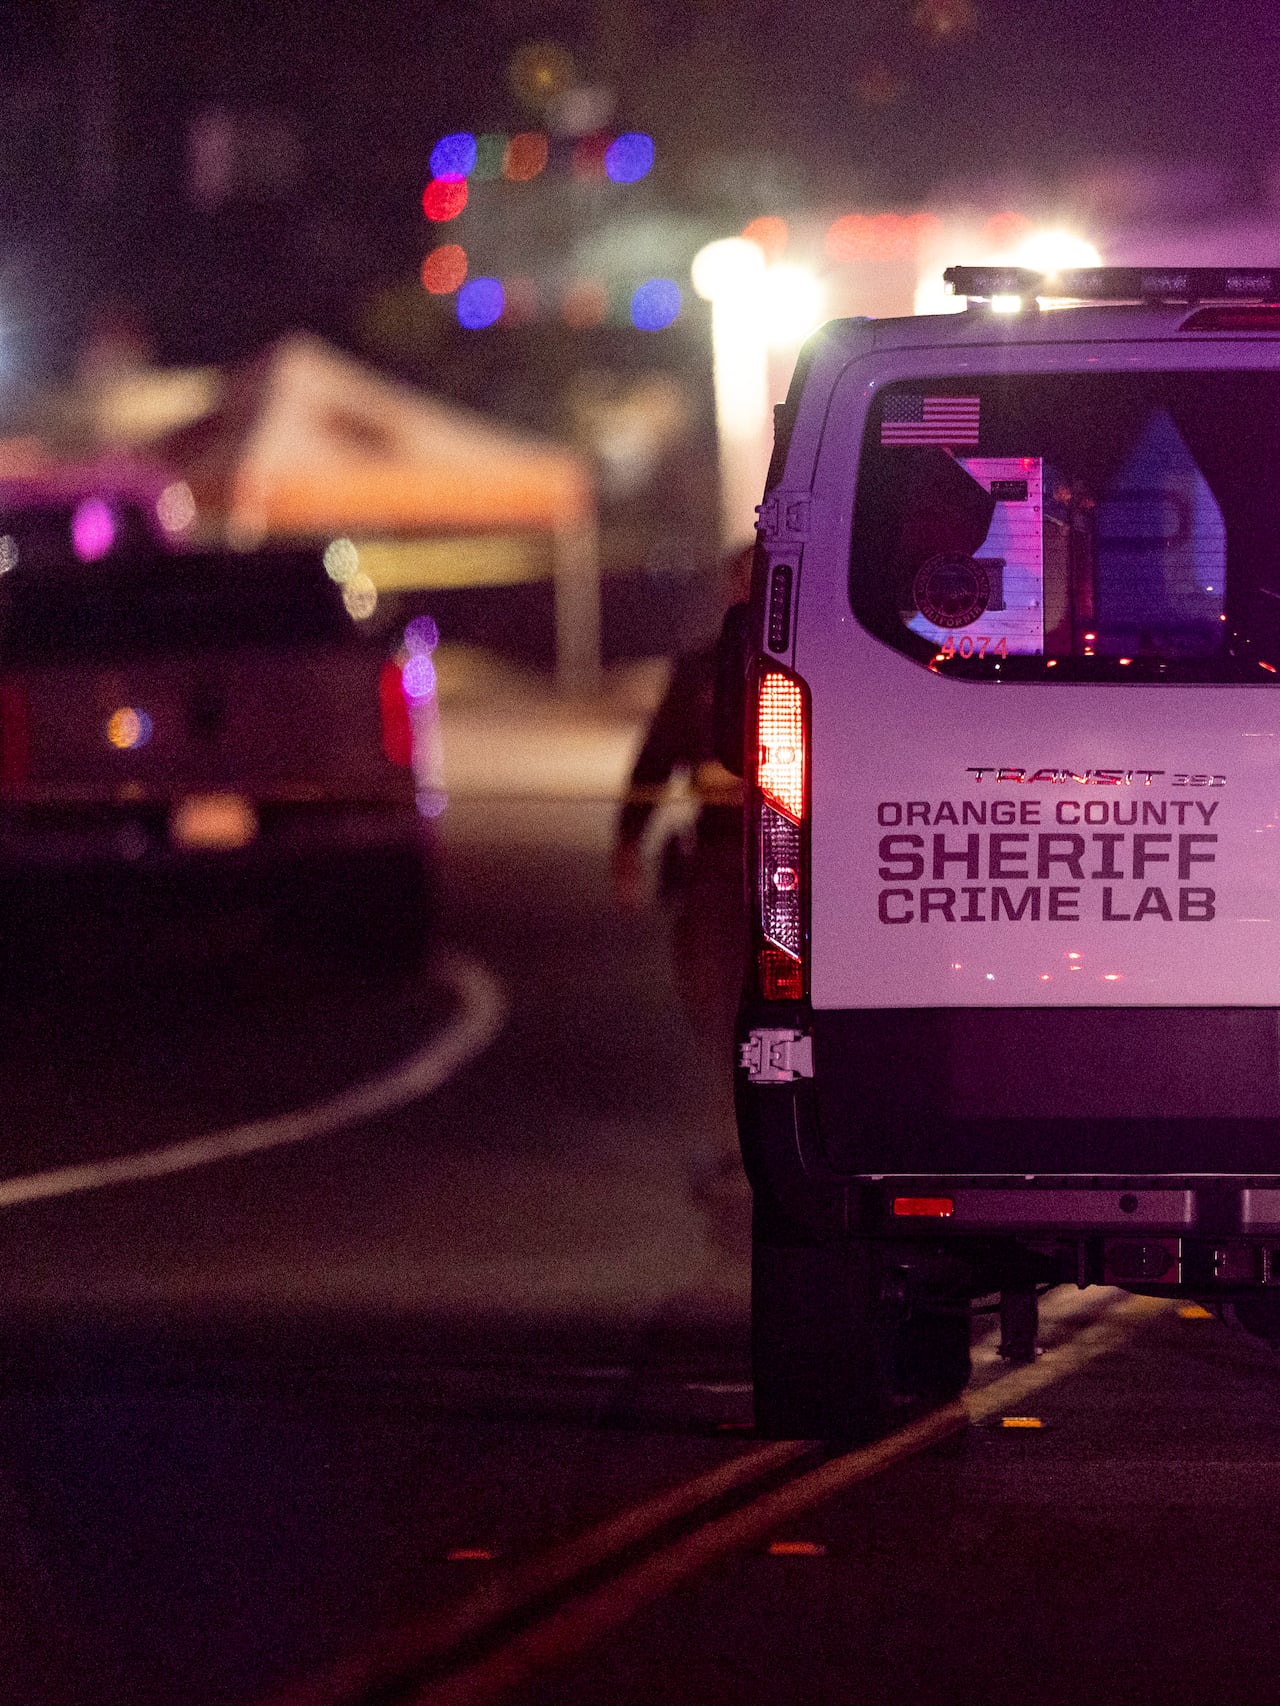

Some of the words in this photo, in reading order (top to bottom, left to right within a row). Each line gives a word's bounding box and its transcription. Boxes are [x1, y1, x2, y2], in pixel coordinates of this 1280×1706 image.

[941, 636, 1008, 659] 4074
[965, 767, 1166, 787] TRANSIT
[877, 801, 1042, 826] ORANGE
[1055, 801, 1219, 826] COUNTY
[878, 833, 1218, 881] SHERIFF
[878, 887, 1080, 924] CRIME
[1101, 886, 1216, 922] LAB
